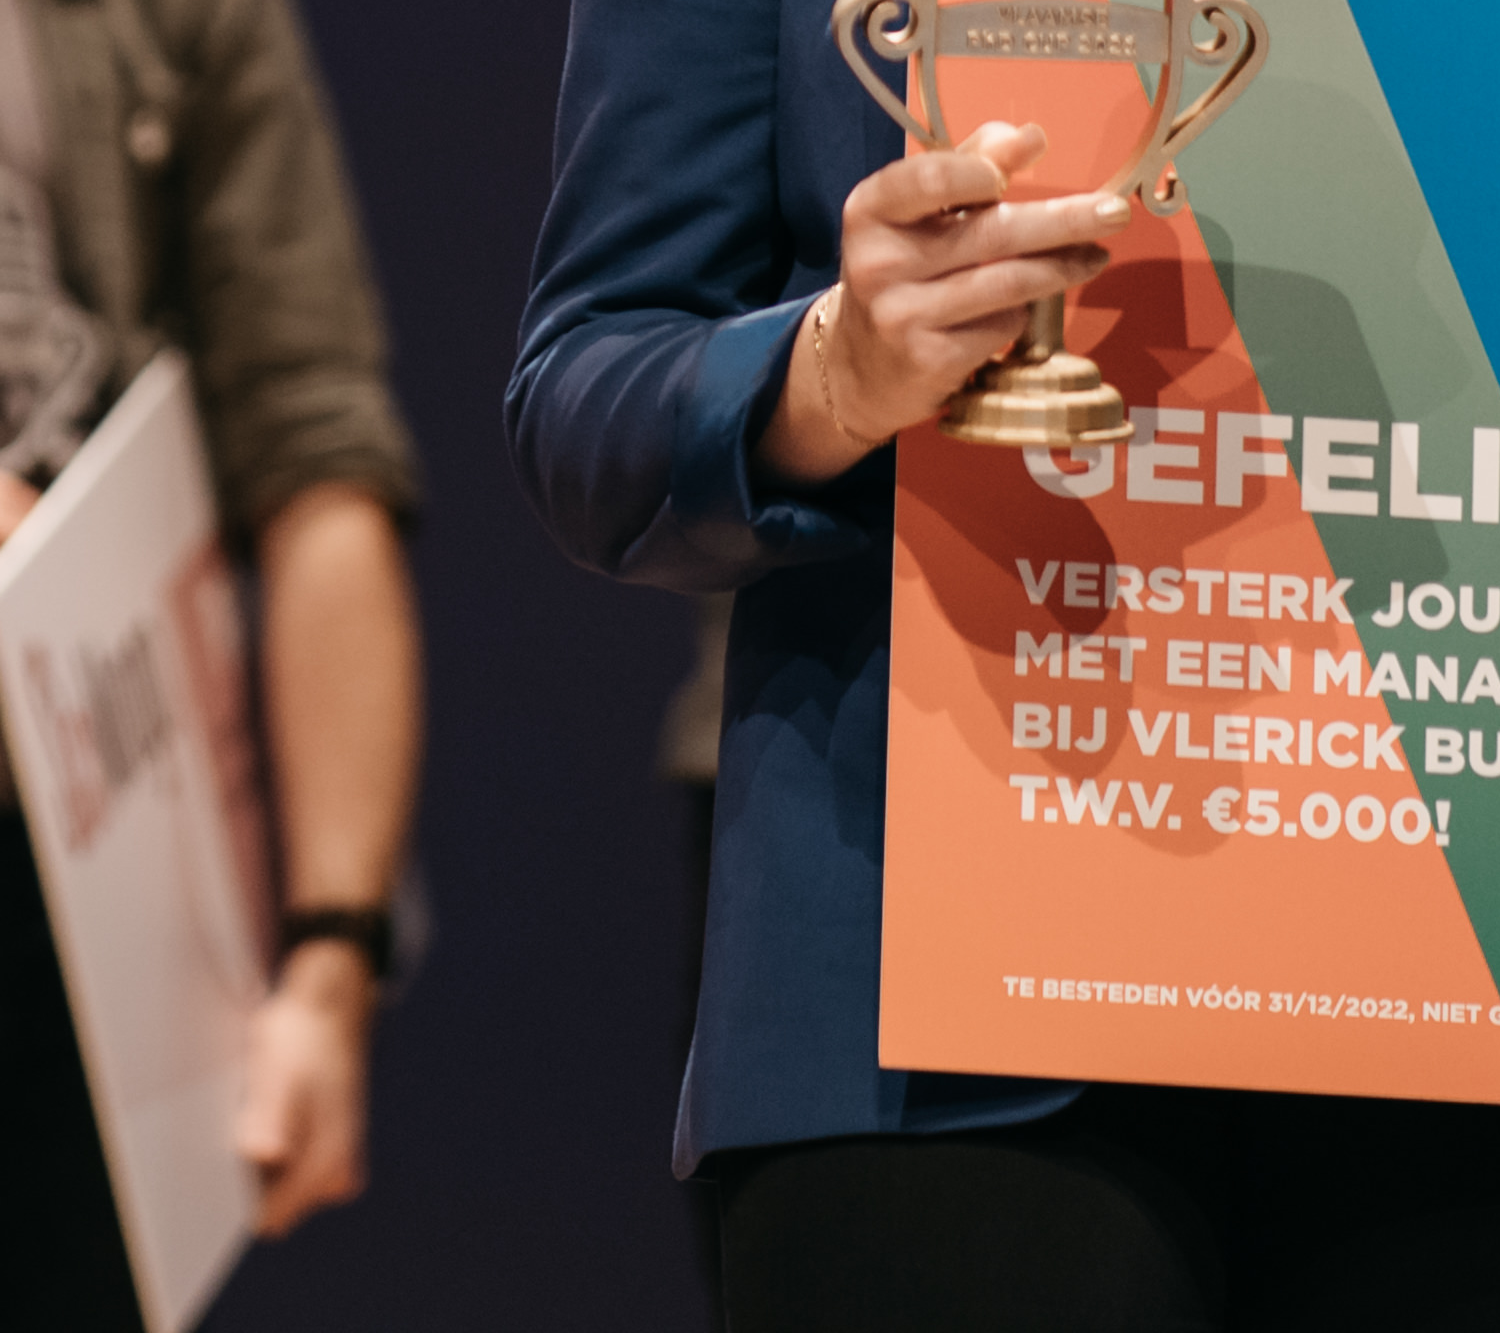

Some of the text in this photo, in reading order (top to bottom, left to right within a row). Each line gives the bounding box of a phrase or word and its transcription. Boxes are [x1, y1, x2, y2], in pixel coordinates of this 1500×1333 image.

[1014, 558, 1355, 625] VERSTERK
[1014, 630, 1148, 684] MET
[1165, 639, 1292, 692] EEN
[1012, 701, 1108, 753] BIJ
[1127, 708, 1406, 772] VLERICK
[1008, 773, 1451, 847] T.W.V. €5.000!
[1002, 975, 1035, 999] TE
[1042, 979, 1179, 1007] BESTEDEN
[1185, 983, 1261, 1012] VÓÓR
[1267, 991, 1416, 1025] 31/12/2022,
[1422, 1000, 1482, 1025] NIET
